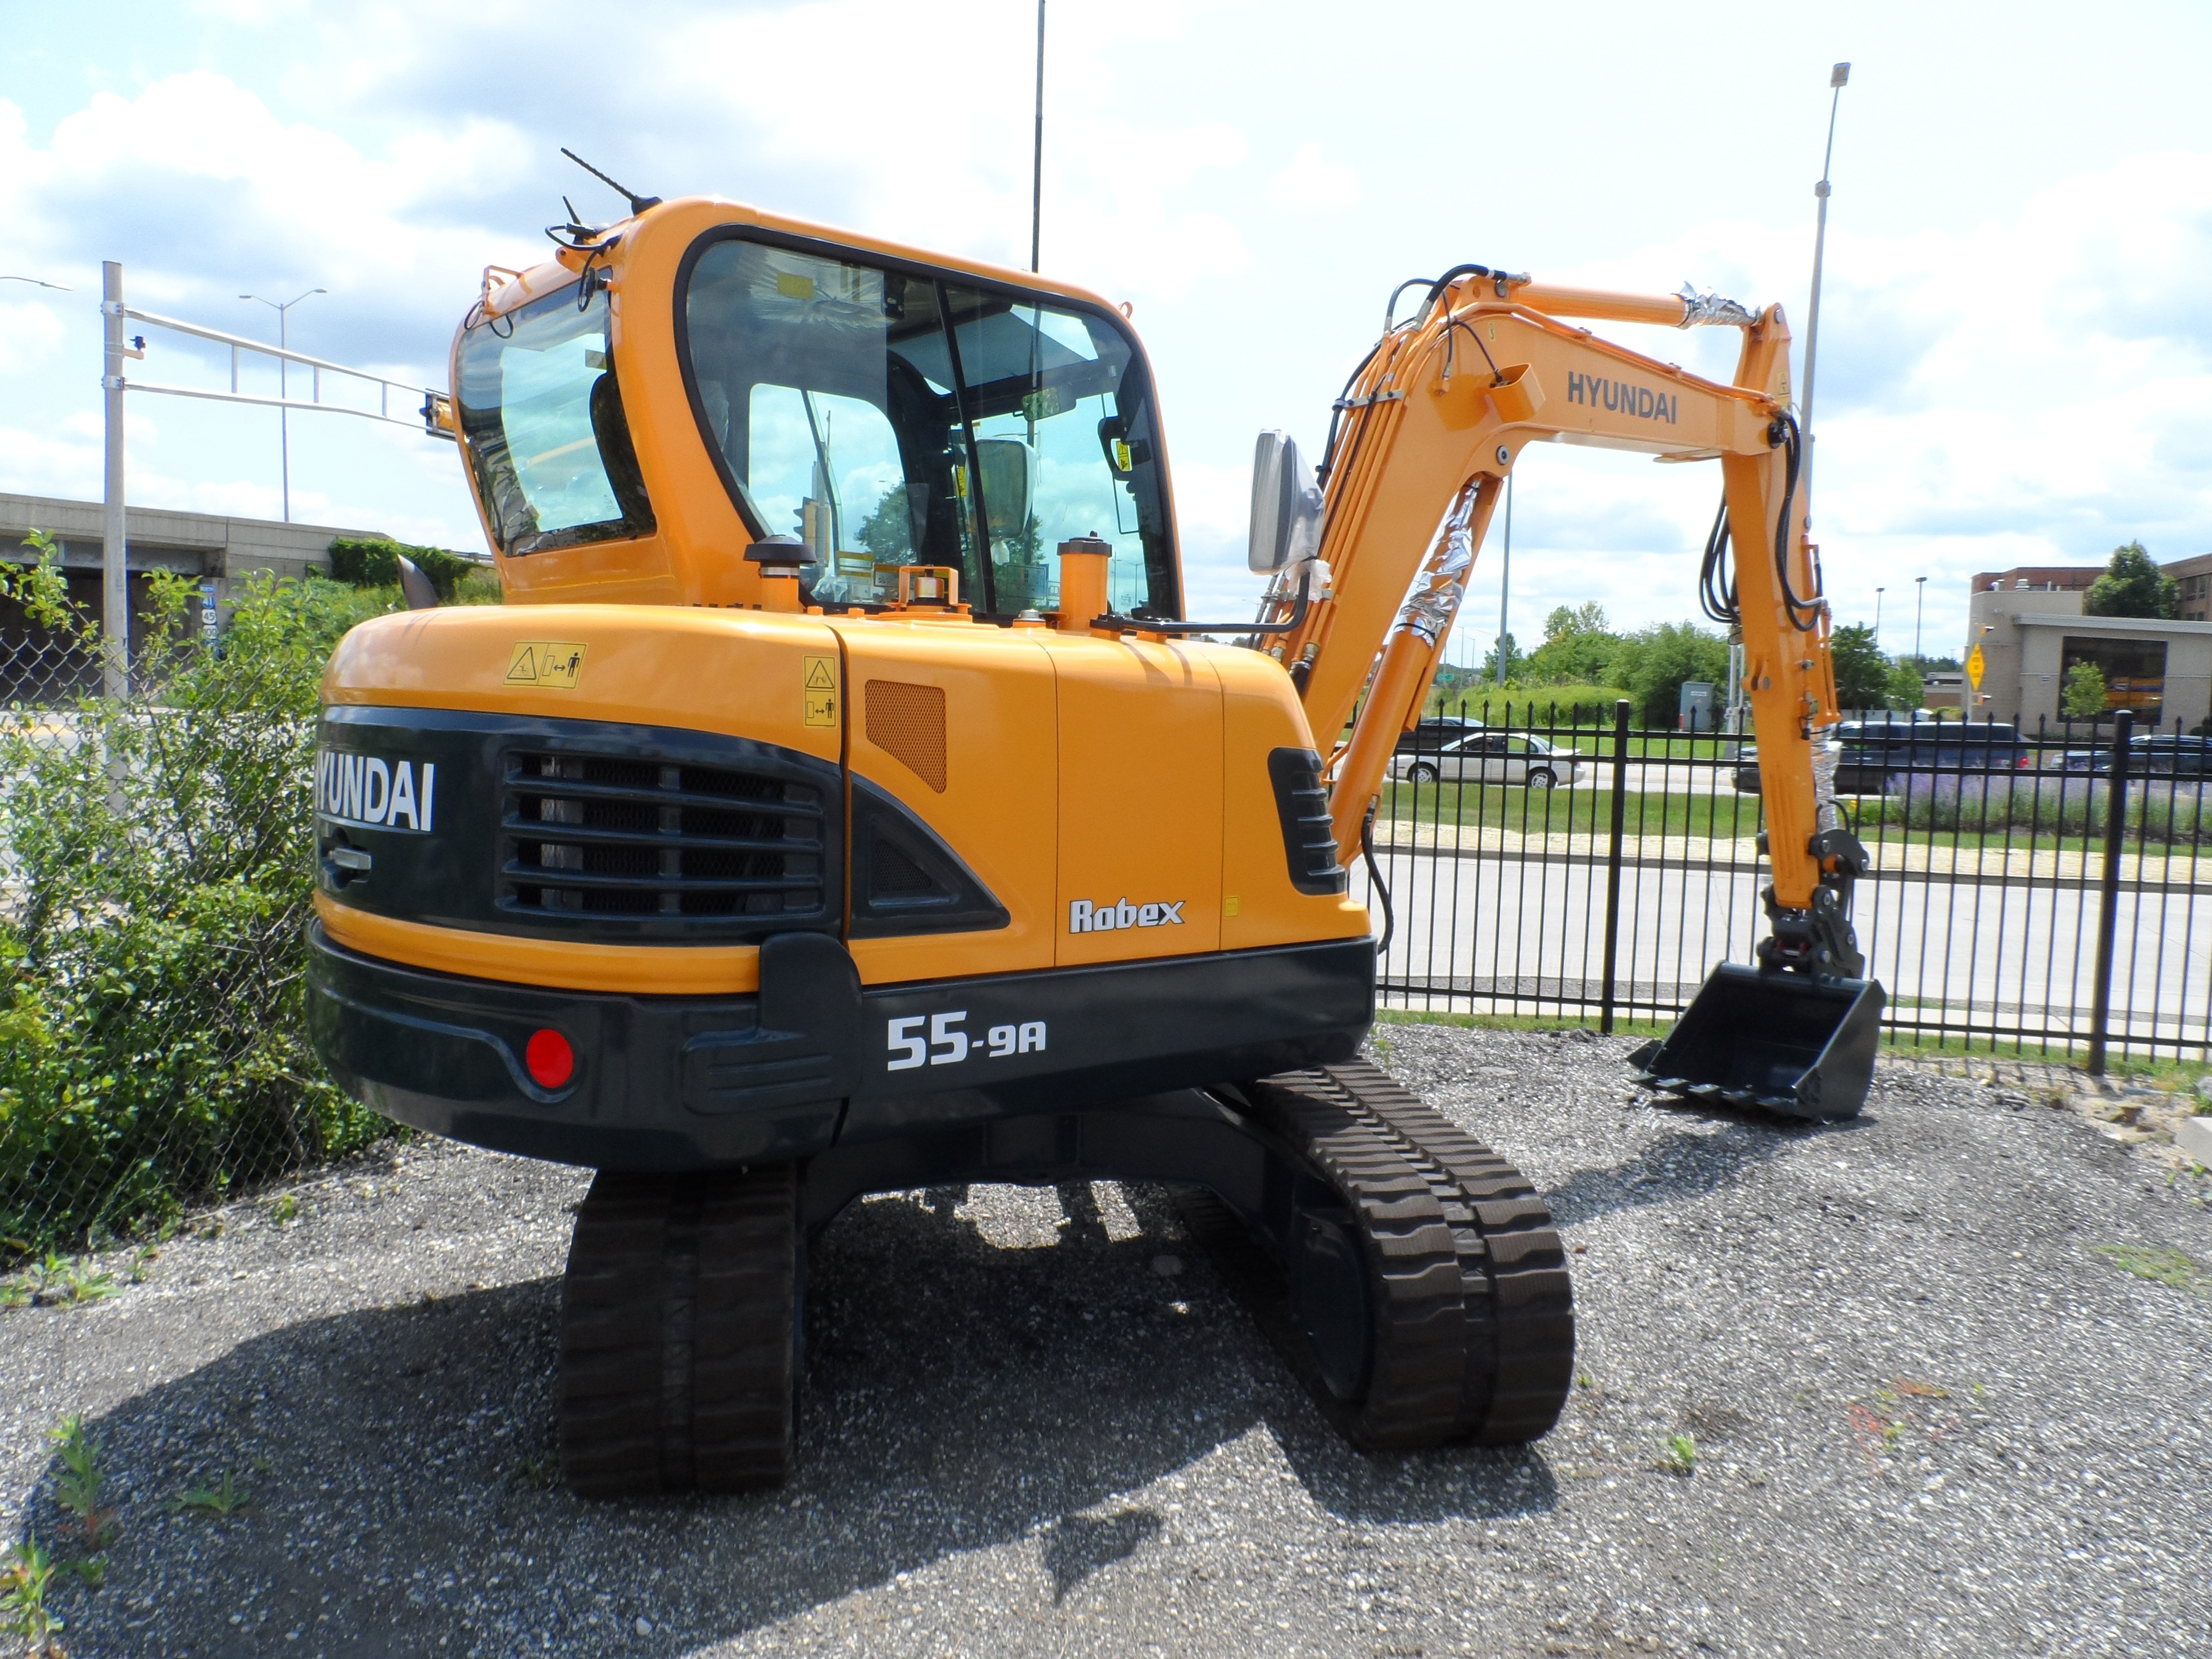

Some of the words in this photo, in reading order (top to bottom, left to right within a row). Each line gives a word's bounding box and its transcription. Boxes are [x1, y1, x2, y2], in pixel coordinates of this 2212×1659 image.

[1568, 371, 1676, 424] HYUNDAI
[204, 612, 215, 621] 45
[1070, 897, 1185, 933] Robex
[887, 1011, 1046, 1071] 55-9A
